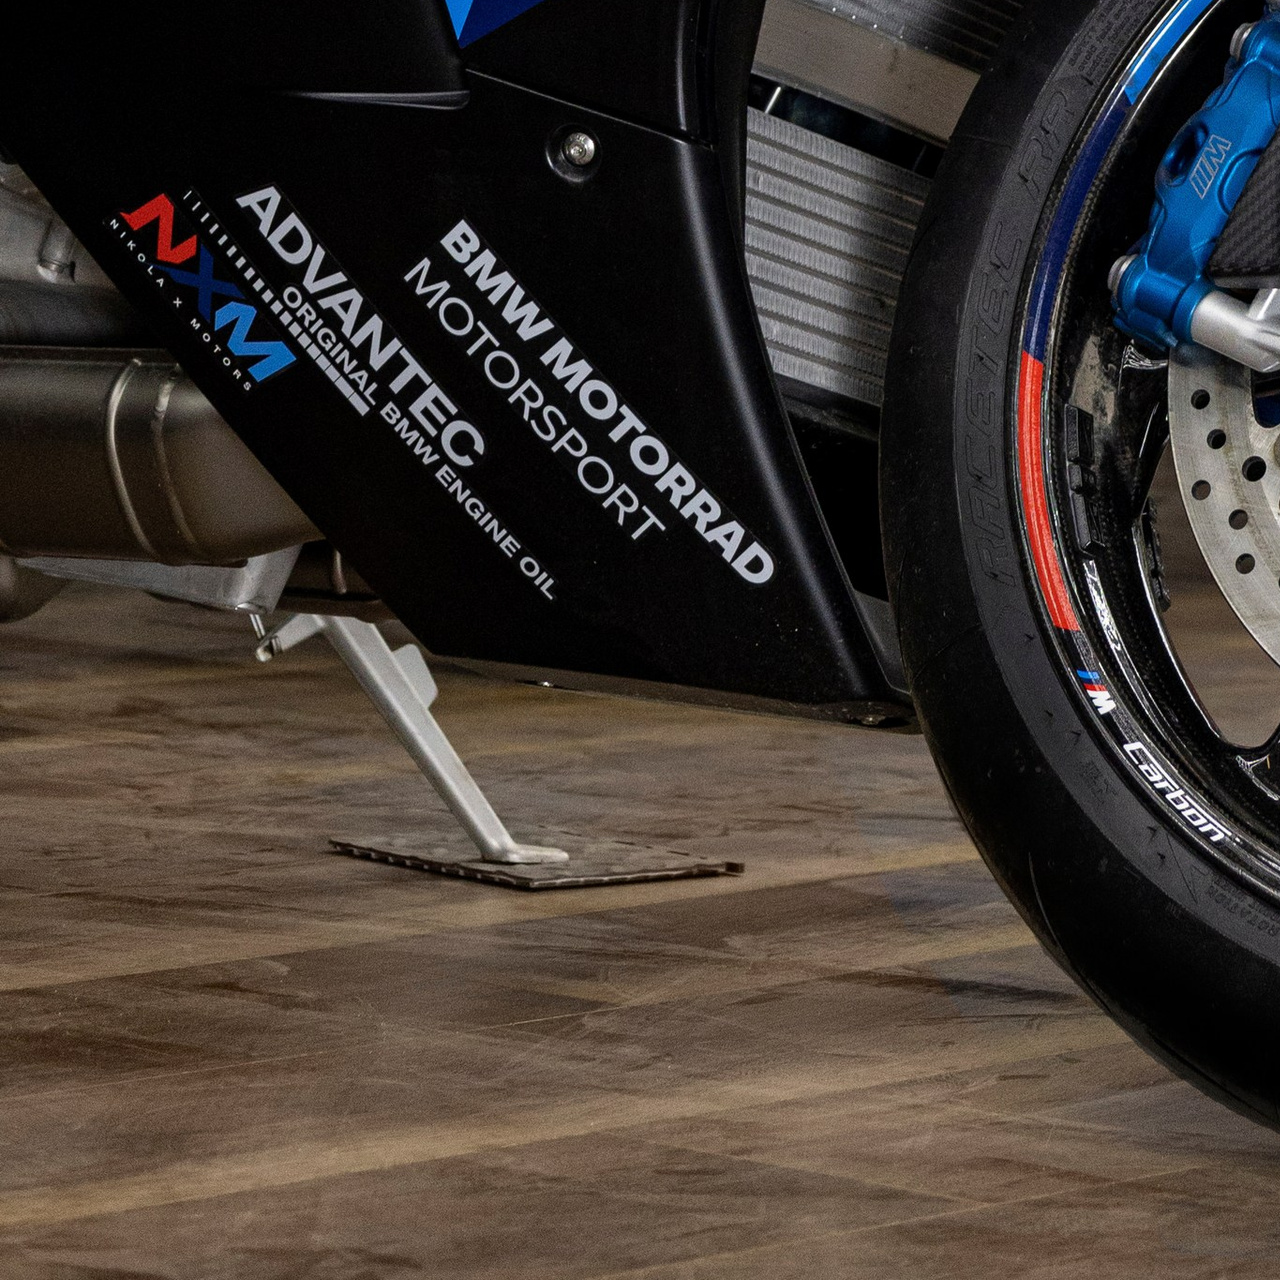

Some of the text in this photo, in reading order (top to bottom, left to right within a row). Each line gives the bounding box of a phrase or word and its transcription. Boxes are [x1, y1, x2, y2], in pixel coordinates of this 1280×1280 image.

[110, 219, 165, 287] NIKOLA
[190, 318, 252, 391] MOTORS
[119, 193, 297, 382] NXM
[236, 186, 485, 467] ADVANTEC
[403, 257, 666, 540] MOTORSPORT
[440, 219, 774, 584] BMW MOTORRAD
[282, 286, 557, 601] ORIGINAL BMW ENGINE OIL
[1123, 741, 1233, 842] Carbon
